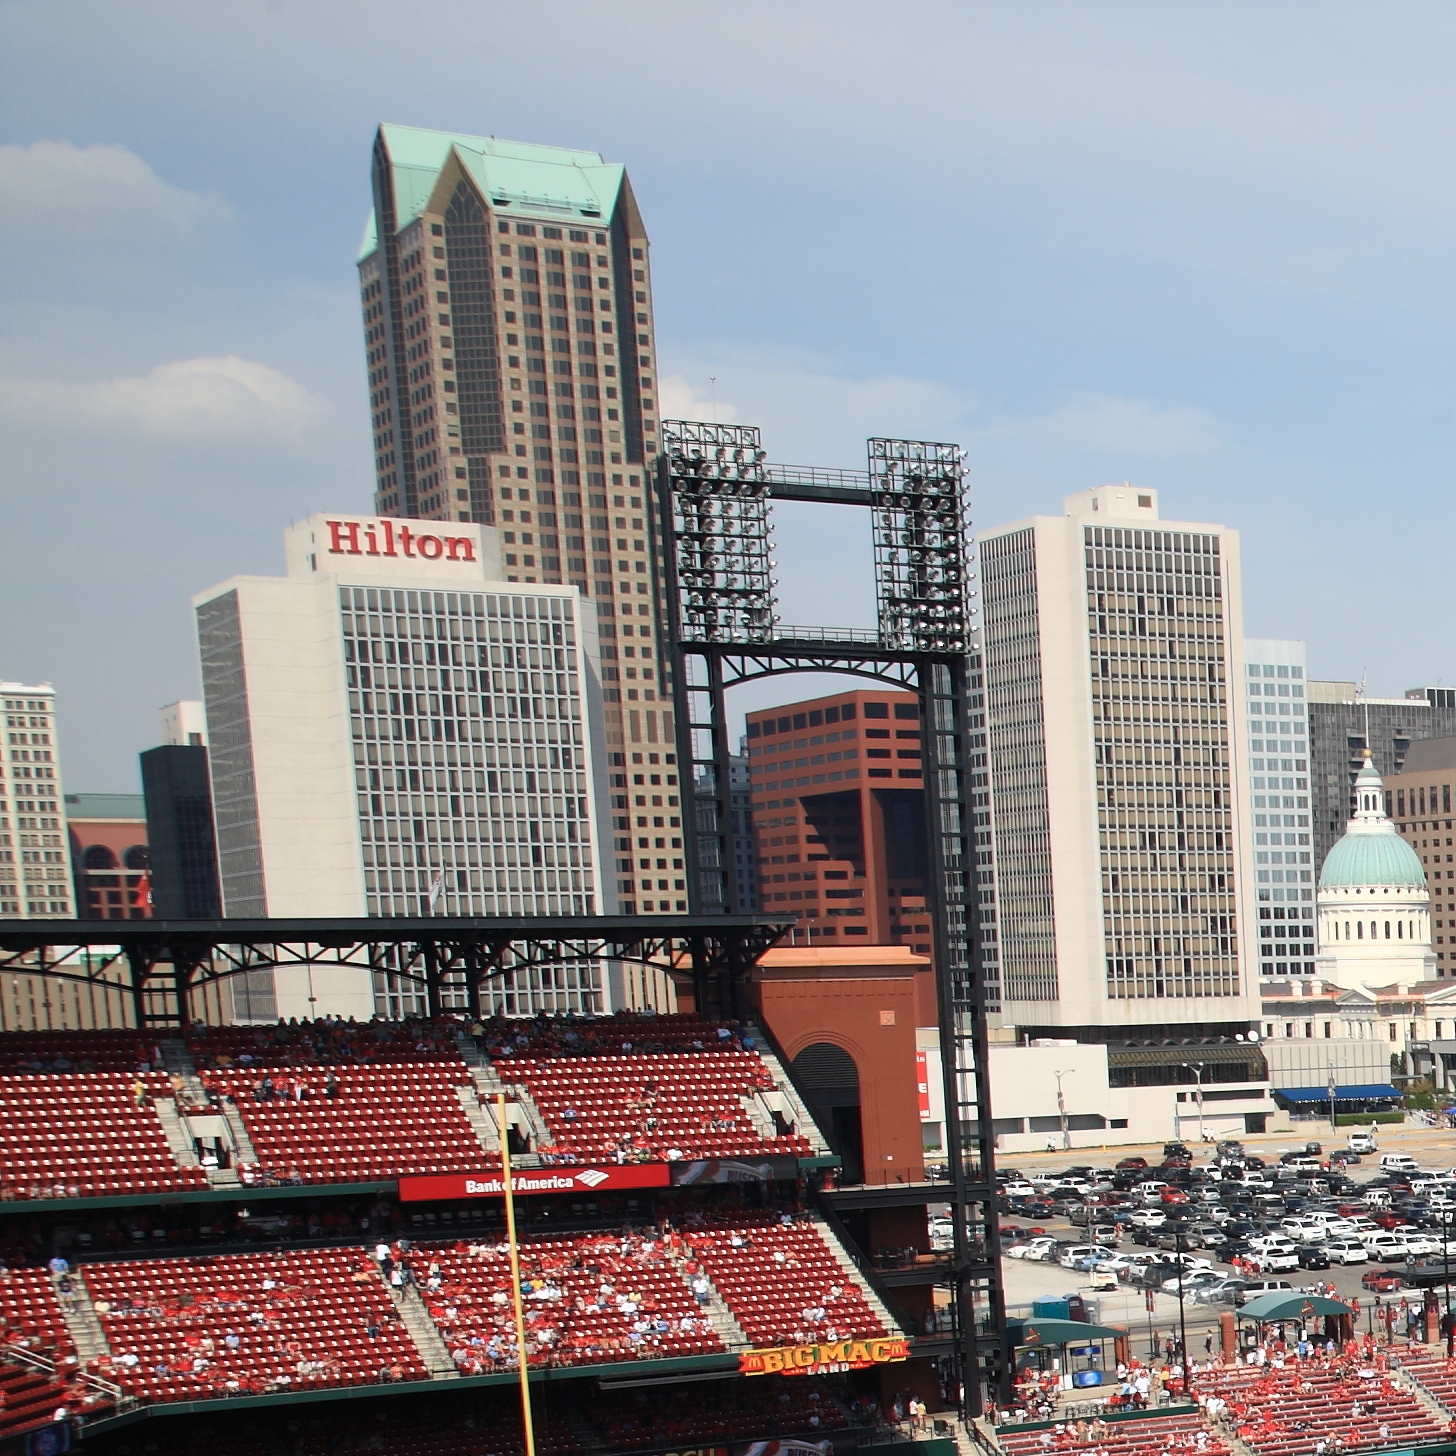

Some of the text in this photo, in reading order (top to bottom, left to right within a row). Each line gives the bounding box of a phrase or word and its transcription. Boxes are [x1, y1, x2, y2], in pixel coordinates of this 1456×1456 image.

[326, 520, 477, 563] Hilton
[466, 1174, 574, 1194] Bank America
[765, 1341, 890, 1373] BIG MAC
[807, 1362, 851, 1375] LAND
